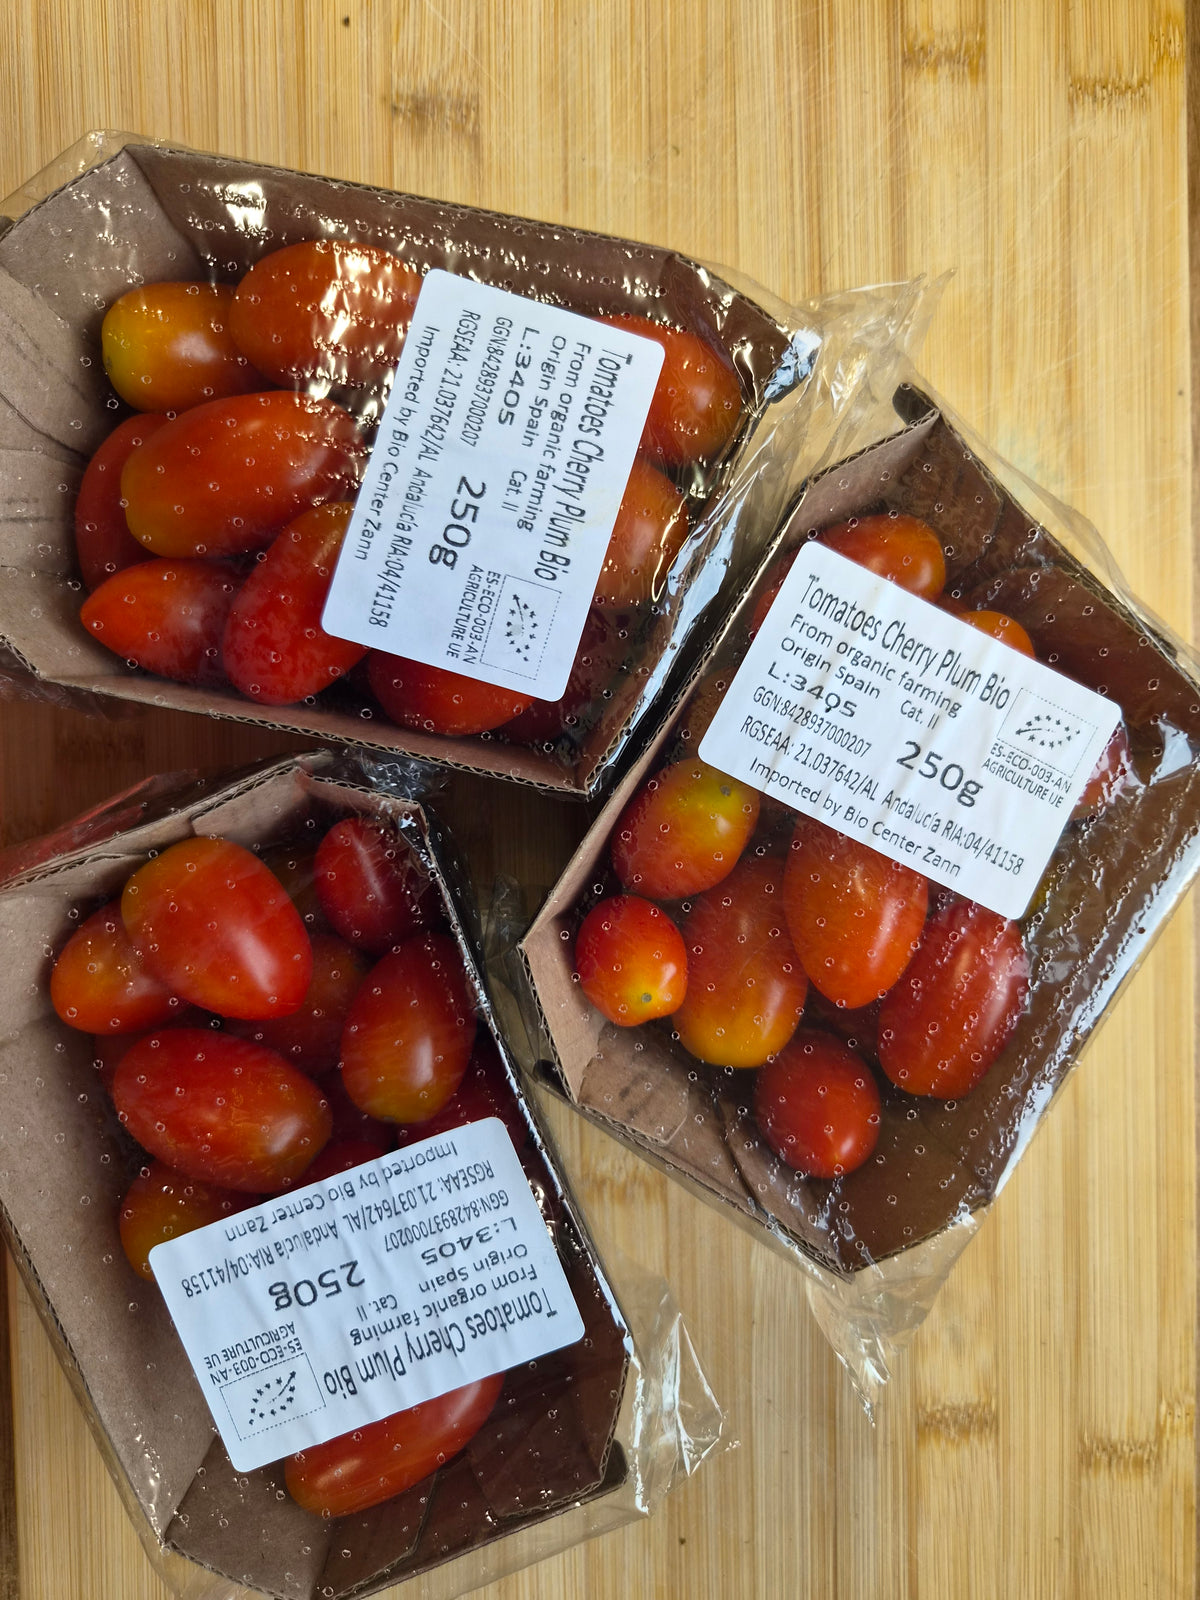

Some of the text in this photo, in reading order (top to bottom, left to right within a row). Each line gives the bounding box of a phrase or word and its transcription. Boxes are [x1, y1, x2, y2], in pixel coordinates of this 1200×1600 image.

[459, 316, 514, 448] GGN:8428937000207
[497, 326, 540, 426] L:3405
[520, 334, 567, 448] Origin Spain
[353, 325, 441, 561] Imported by Bio Center Zann
[367, 308, 482, 628] RGSEAA: 21.037642/AL Andalucía RIA:04/41158
[504, 469, 528, 497] Cat.
[516, 341, 592, 533] From organic farming
[533, 348, 634, 582] Tomatoes Cherry Plum Bio
[427, 475, 487, 571] 250g
[445, 563, 485, 659] AGRICULTURE UE
[461, 569, 502, 665] ES-ECO-003-AN
[799, 573, 1011, 710] Tomatoes Cherry Plum Bio
[766, 660, 858, 718] L:3405
[780, 636, 881, 700] Origin Spain
[789, 612, 963, 719] From organic farming
[899, 698, 923, 725] Cat.
[752, 685, 872, 758] GGN:8428937000207
[989, 742, 1072, 794] ES-ECO-003-AN
[739, 714, 1025, 876] RGSEAA: 21.037642/AL Andalucía RIA:04/41158
[748, 756, 961, 877] Imported by Bio Center Zann
[895, 739, 984, 808] 250g
[980, 757, 1050, 801] AGRICULTURE
[180, 1159, 495, 1299] RGSEAA: 21.037642/AL Andalucía RIA:04/41158
[224, 1140, 458, 1242] Imported by Bio Center Zann
[383, 1189, 510, 1253] GGN:8428937000207
[267, 1259, 366, 1312] 250g
[417, 1243, 528, 1293] Origin Spain
[419, 1216, 518, 1266] L:3405
[202, 1320, 296, 1370] AGRICULTURE UE
[322, 1286, 558, 1400] Tomatoes Cherry Plum Bio
[348, 1263, 538, 1347] From organic farming
[367, 1293, 398, 1314] Cat.
[208, 1336, 303, 1386] ES-ECO-003-AN
